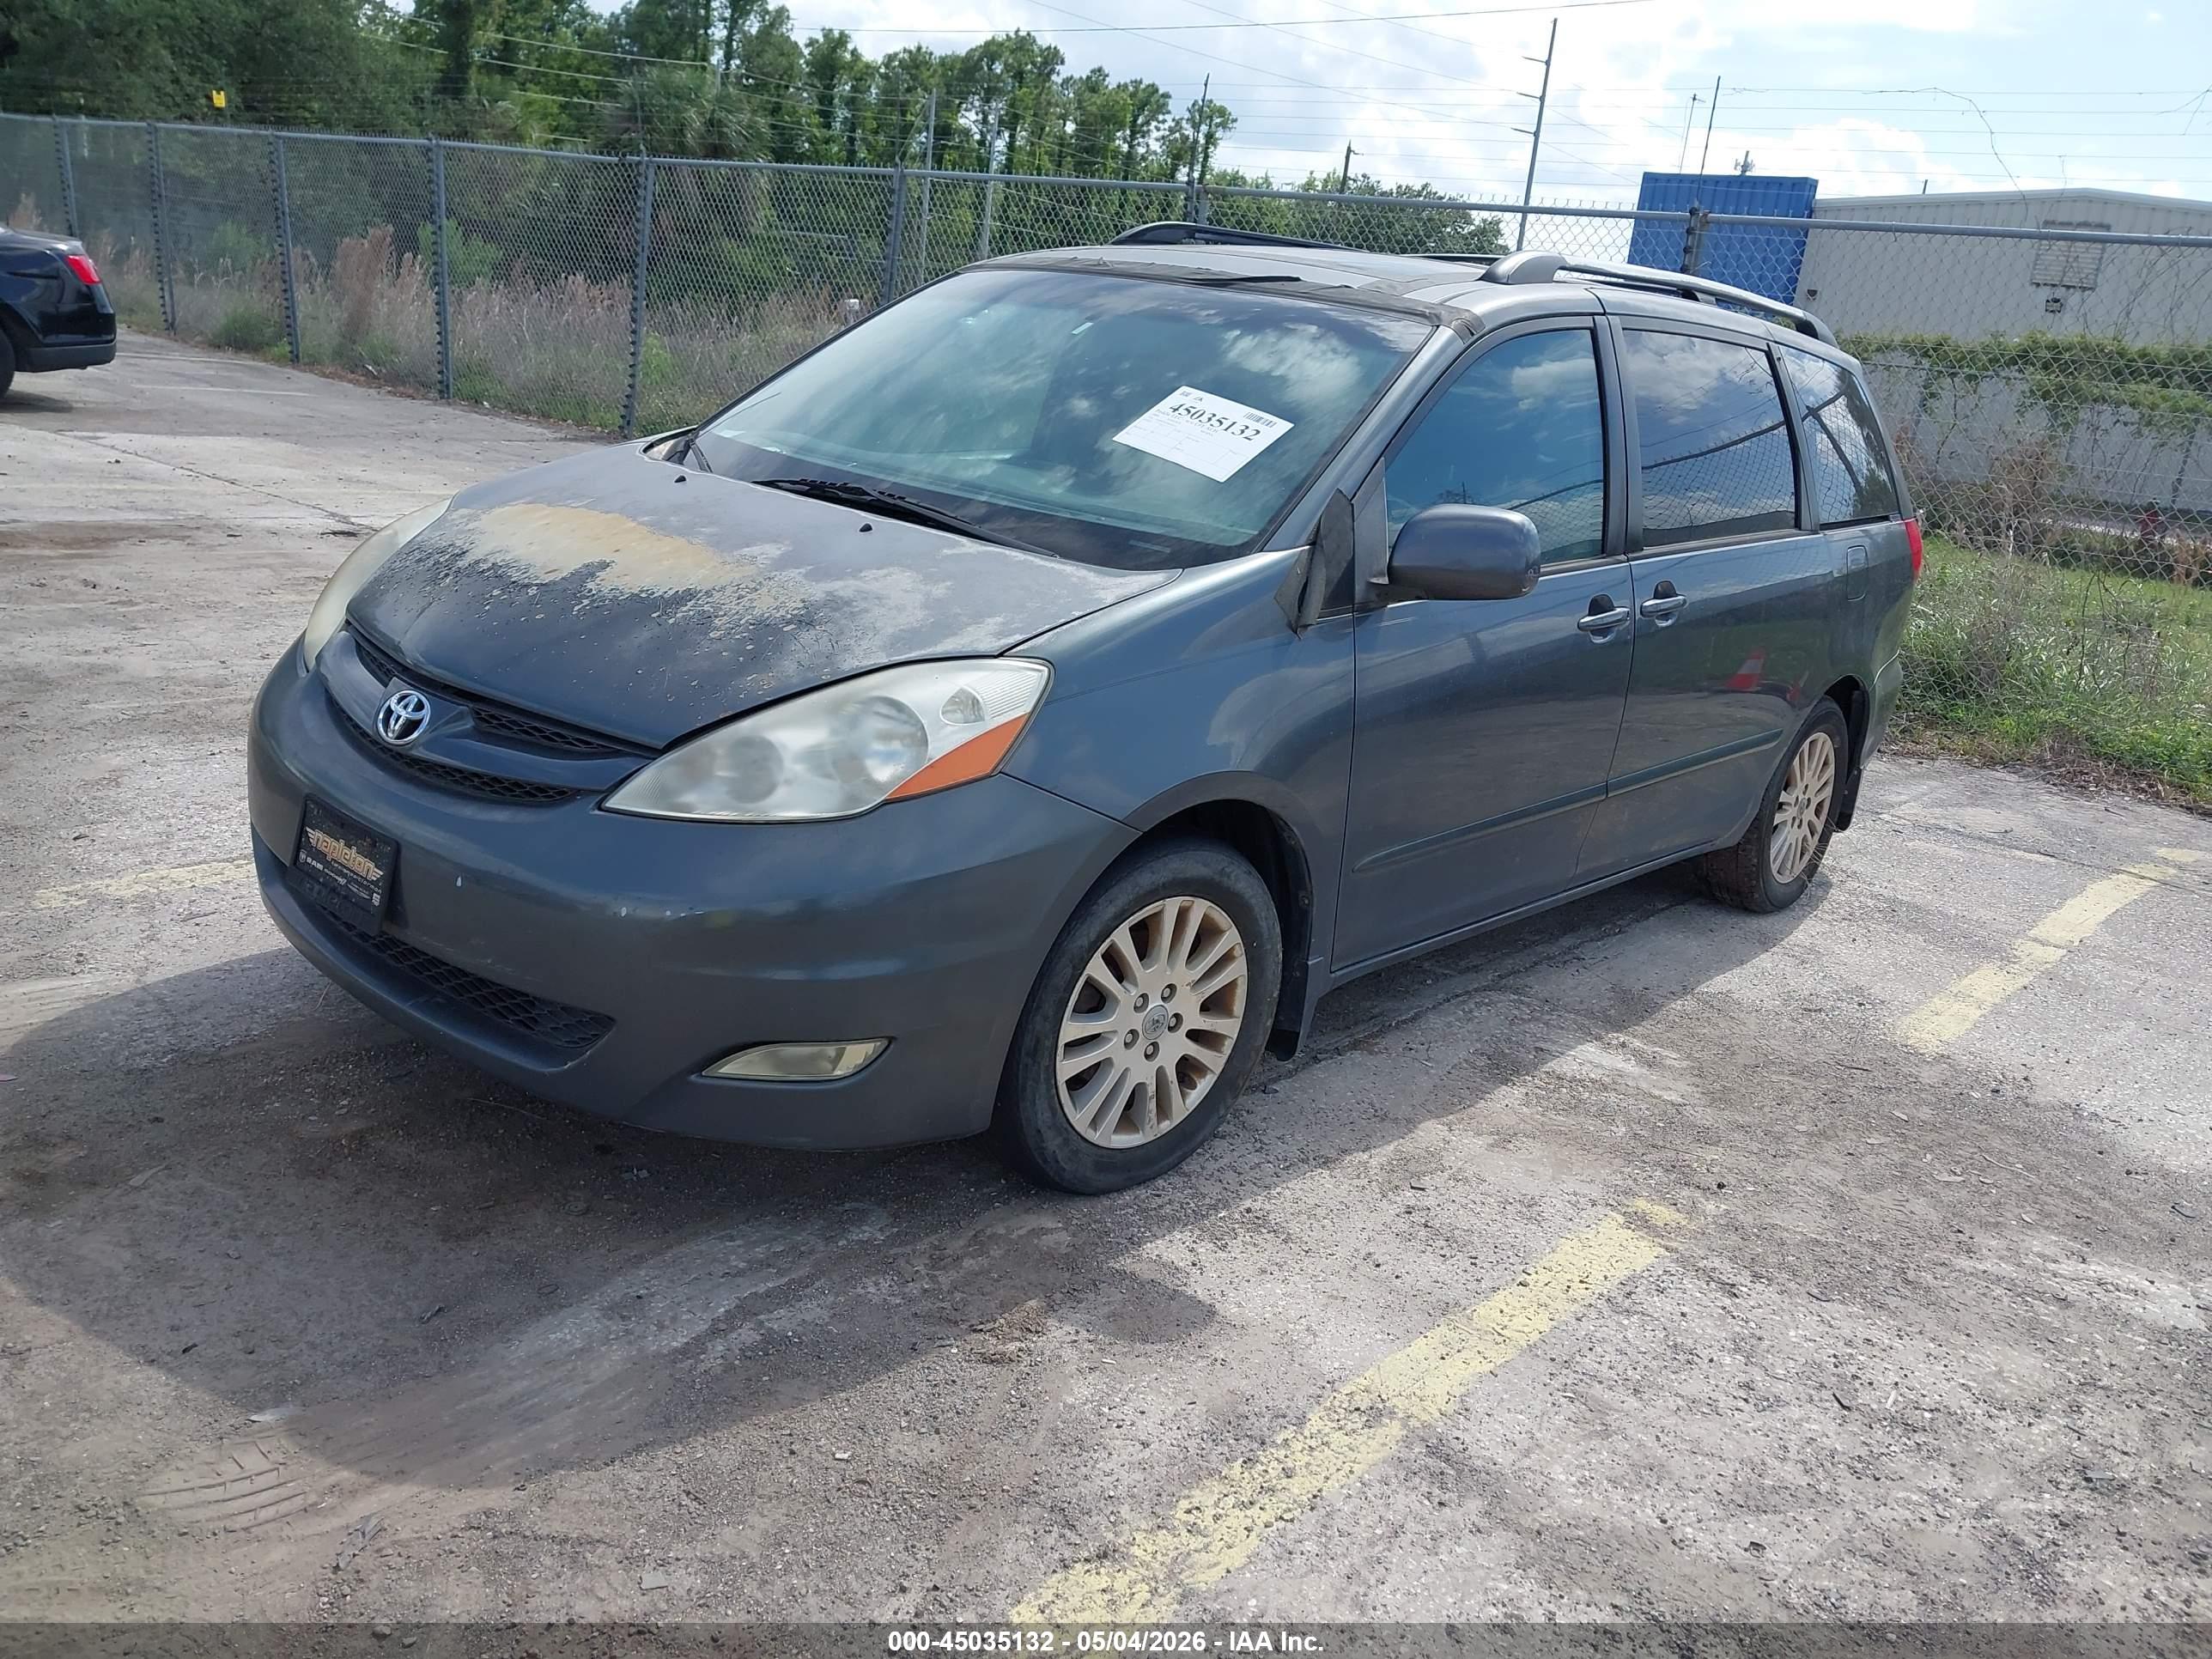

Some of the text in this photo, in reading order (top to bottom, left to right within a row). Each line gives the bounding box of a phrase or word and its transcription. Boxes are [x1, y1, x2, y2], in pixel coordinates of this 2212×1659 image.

[1169, 403, 1261, 441] 45035132
[307, 857, 324, 871] RAM
[312, 829, 375, 880] napleton
